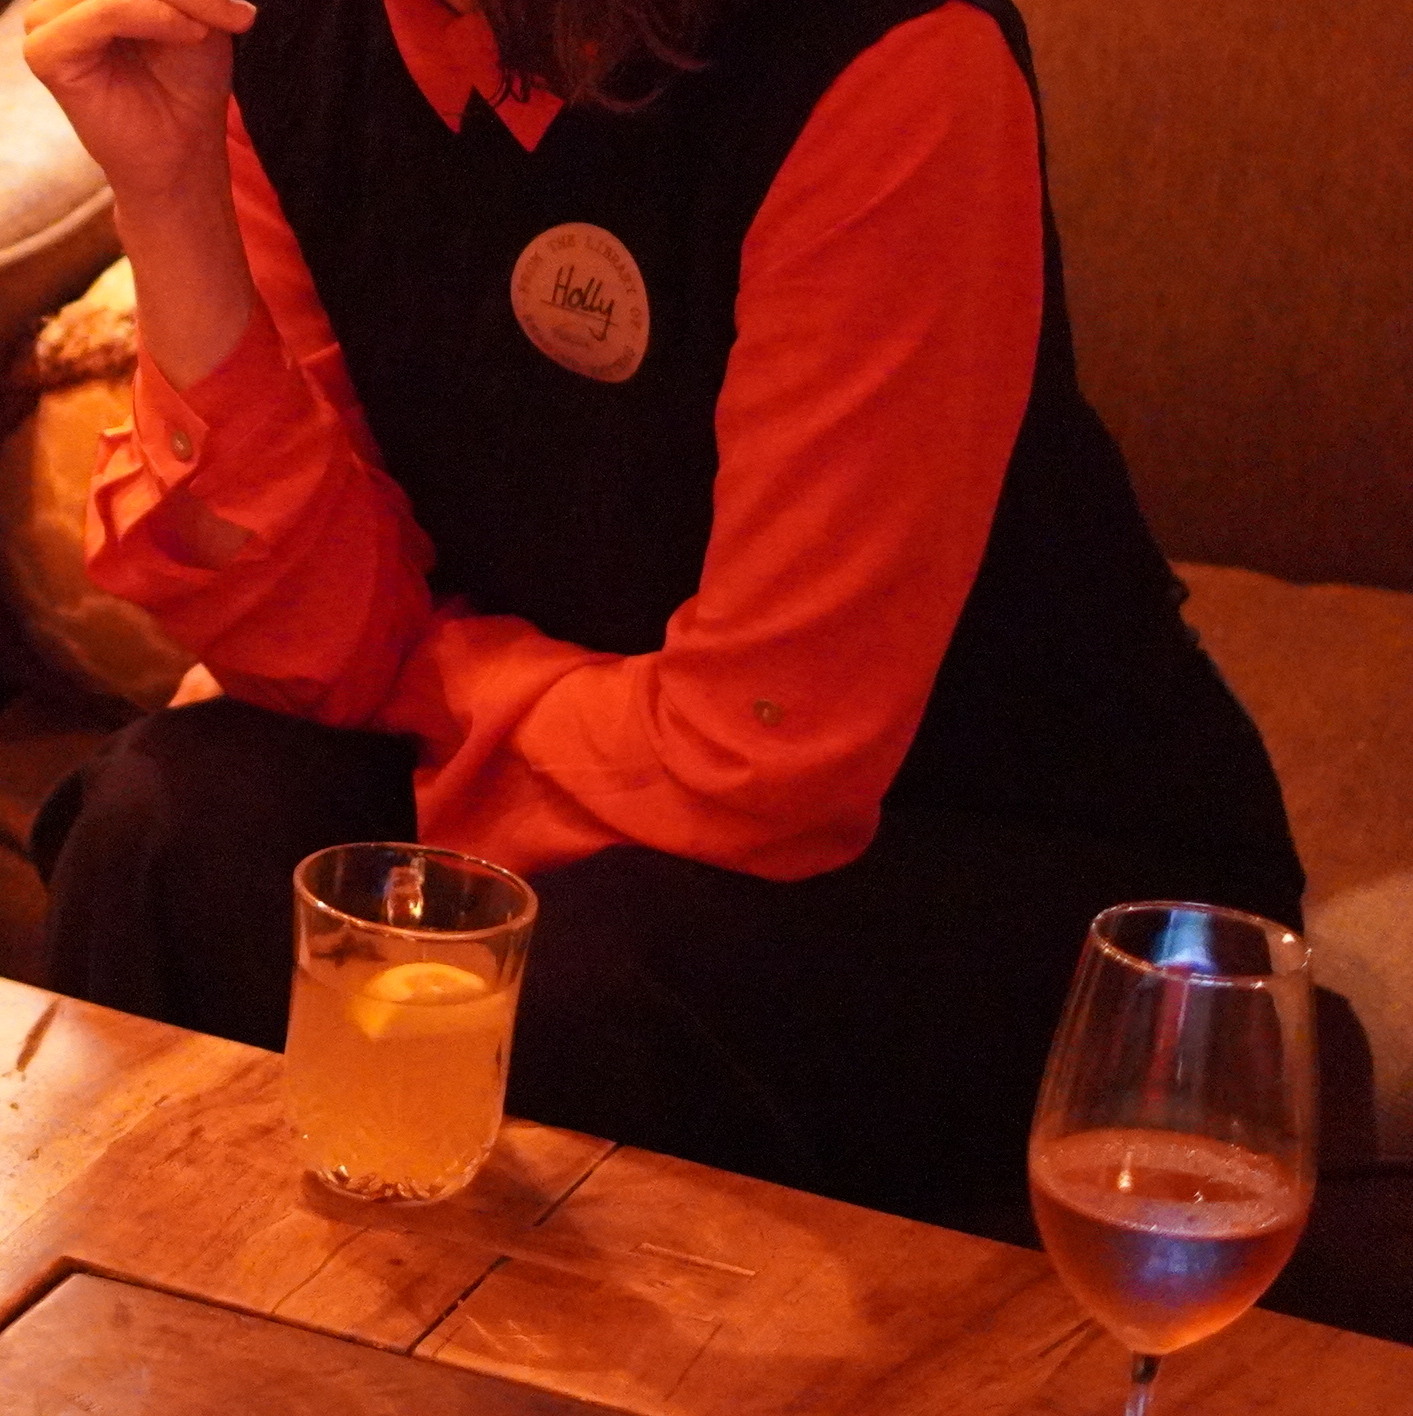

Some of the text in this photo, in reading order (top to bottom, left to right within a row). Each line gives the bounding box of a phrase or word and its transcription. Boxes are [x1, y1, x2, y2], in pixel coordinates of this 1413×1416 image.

[548, 234, 575, 252] THE
[585, 235, 637, 295] LIBRARY
[629, 307, 641, 330] OF
[552, 265, 615, 341] Holly
